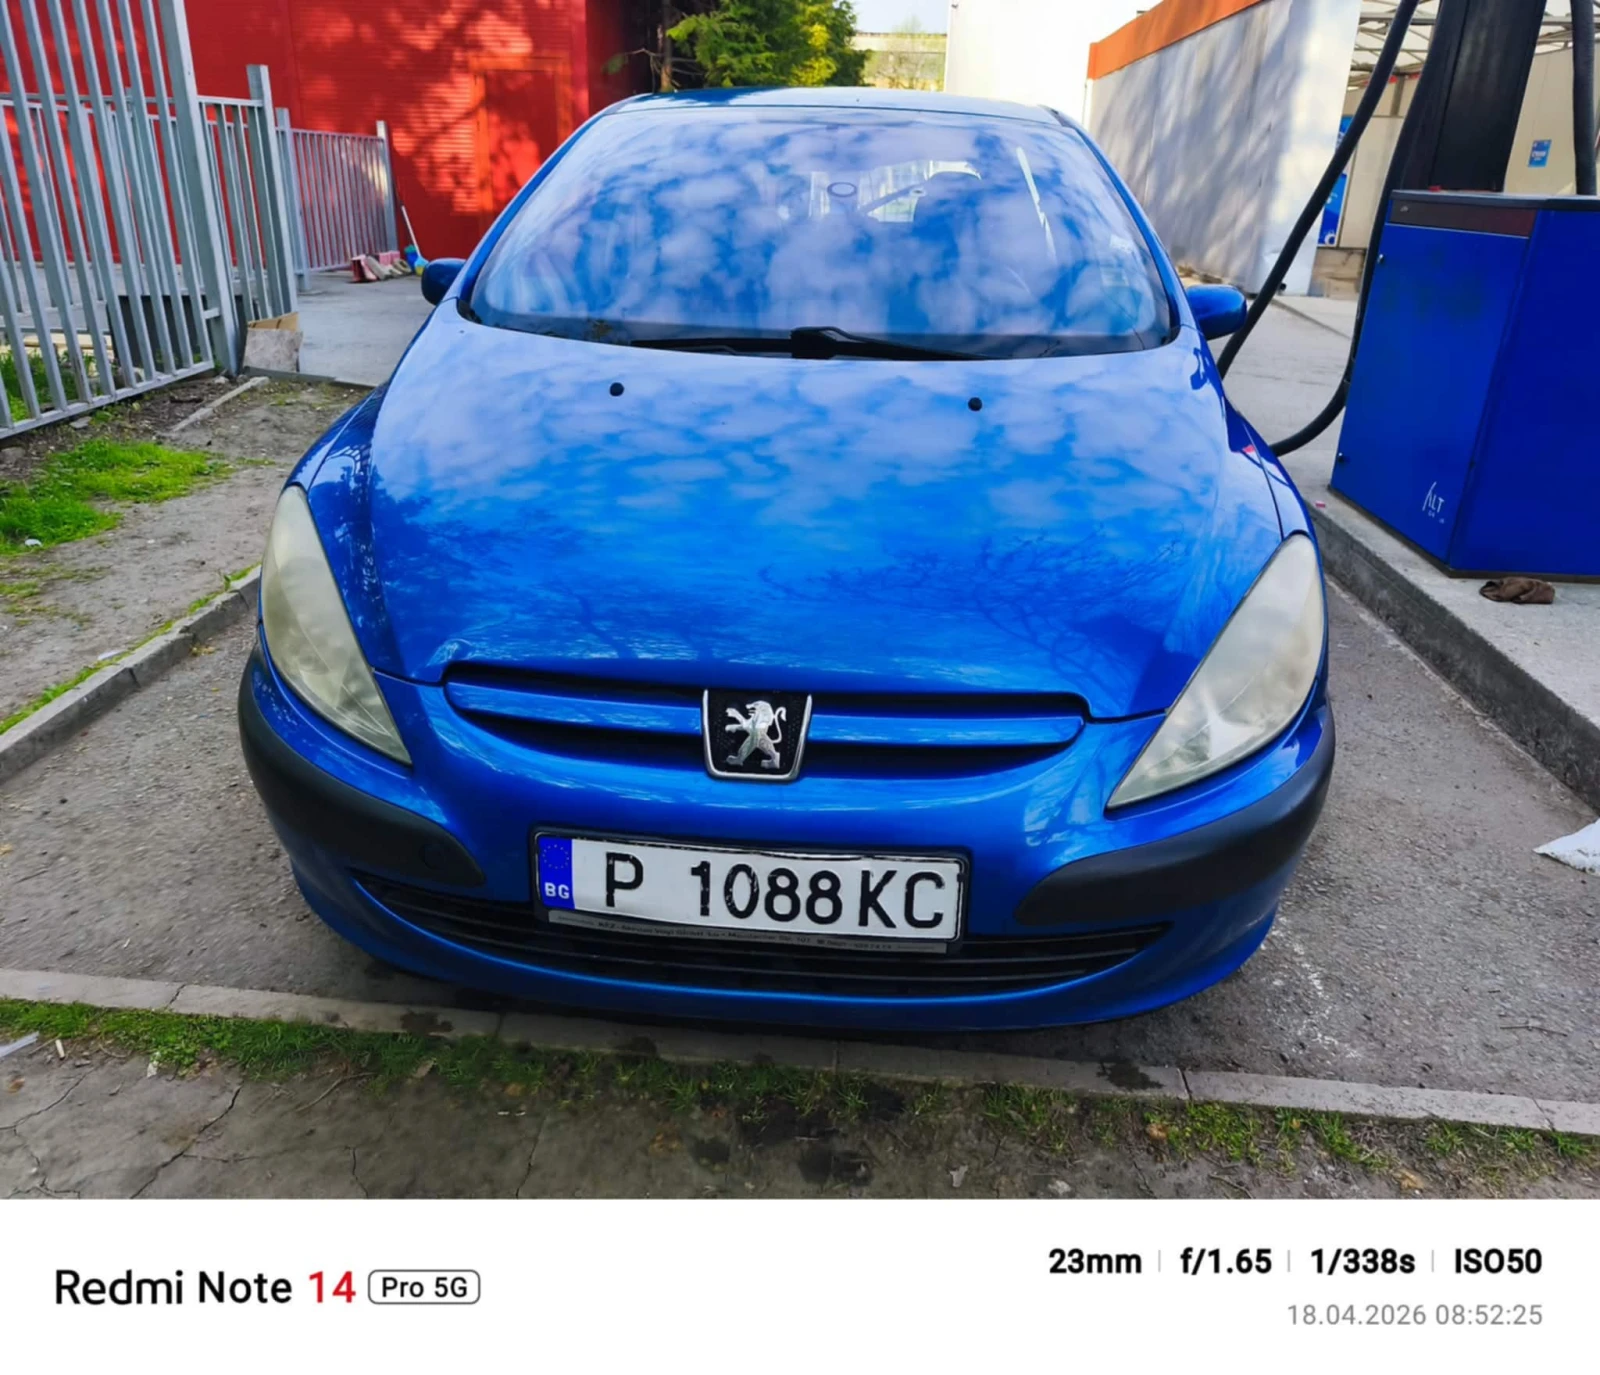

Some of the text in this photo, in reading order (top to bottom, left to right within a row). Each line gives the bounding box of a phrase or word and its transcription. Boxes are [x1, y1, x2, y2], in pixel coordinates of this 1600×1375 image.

[545, 882, 570, 900] BG
[605, 851, 945, 929] P 1088 KC
